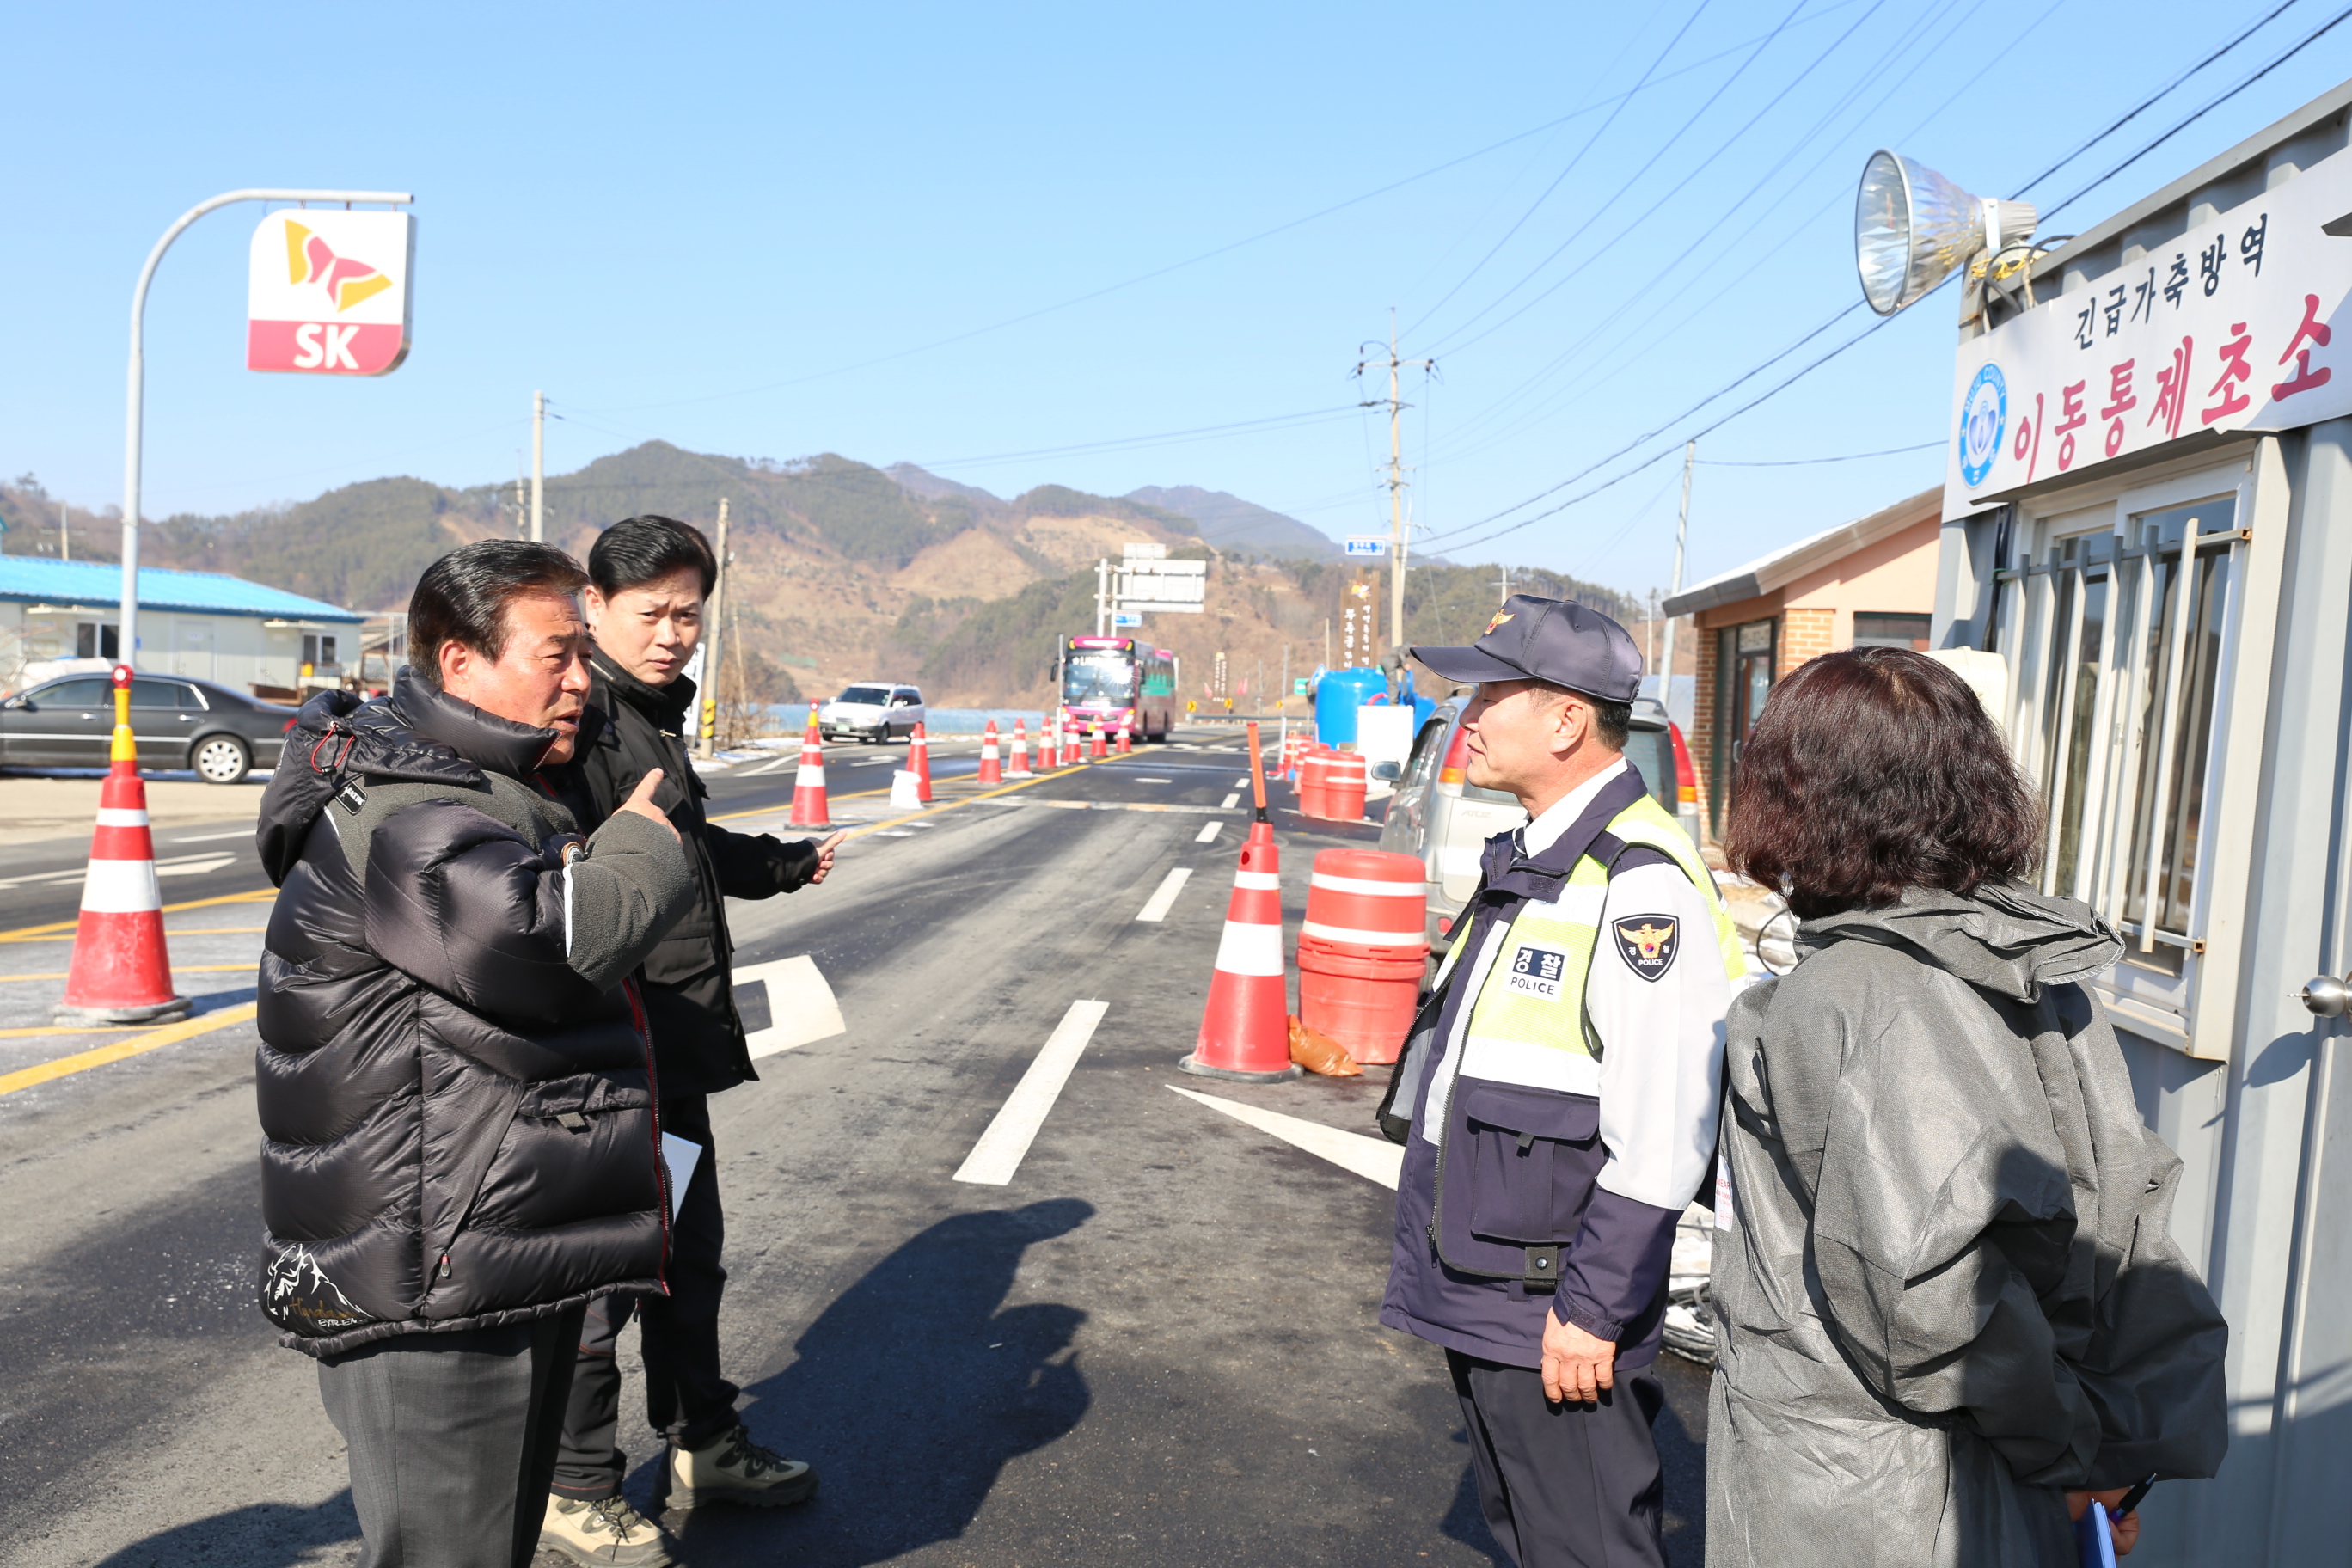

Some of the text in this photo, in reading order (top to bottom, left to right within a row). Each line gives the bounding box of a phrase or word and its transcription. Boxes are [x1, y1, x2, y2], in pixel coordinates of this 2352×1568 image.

[2074, 213, 2268, 350] 긴급가축방역
[292, 322, 360, 370] SK
[2014, 293, 2331, 484] 이동통제초소
[1516, 949, 1561, 979] 경찰
[1638, 958, 1663, 966] POLICE
[1510, 977, 1555, 995] POLICE
